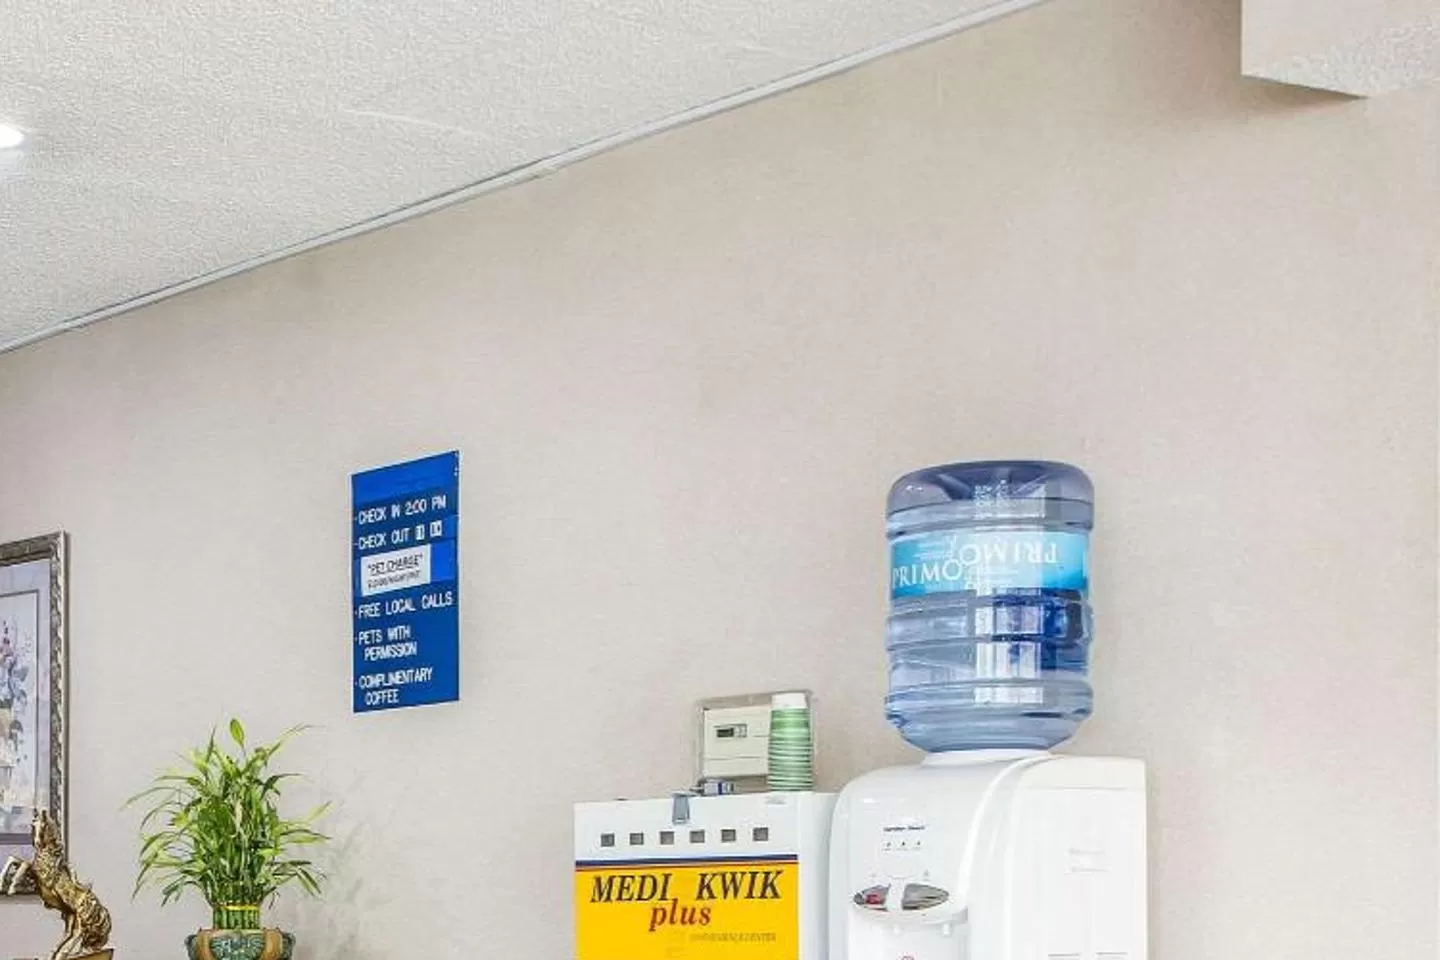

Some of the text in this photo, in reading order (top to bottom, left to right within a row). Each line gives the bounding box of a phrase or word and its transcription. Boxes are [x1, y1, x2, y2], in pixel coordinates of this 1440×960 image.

[358, 506, 387, 525] CHECK
[391, 503, 401, 519] IN
[431, 494, 447, 510] PM
[358, 533, 387, 550] CHECK
[391, 527, 410, 544] OUT
[960, 543, 1057, 565] PRIMO
[892, 559, 962, 589] PRIMO
[358, 591, 453, 618] FREE LOCAL CALLS
[358, 625, 411, 645] PETS WITH
[364, 642, 418, 661] PERMISSION
[365, 688, 399, 706] COFFEE
[590, 869, 784, 904] MEDI KWIK
[648, 898, 712, 932] plus
